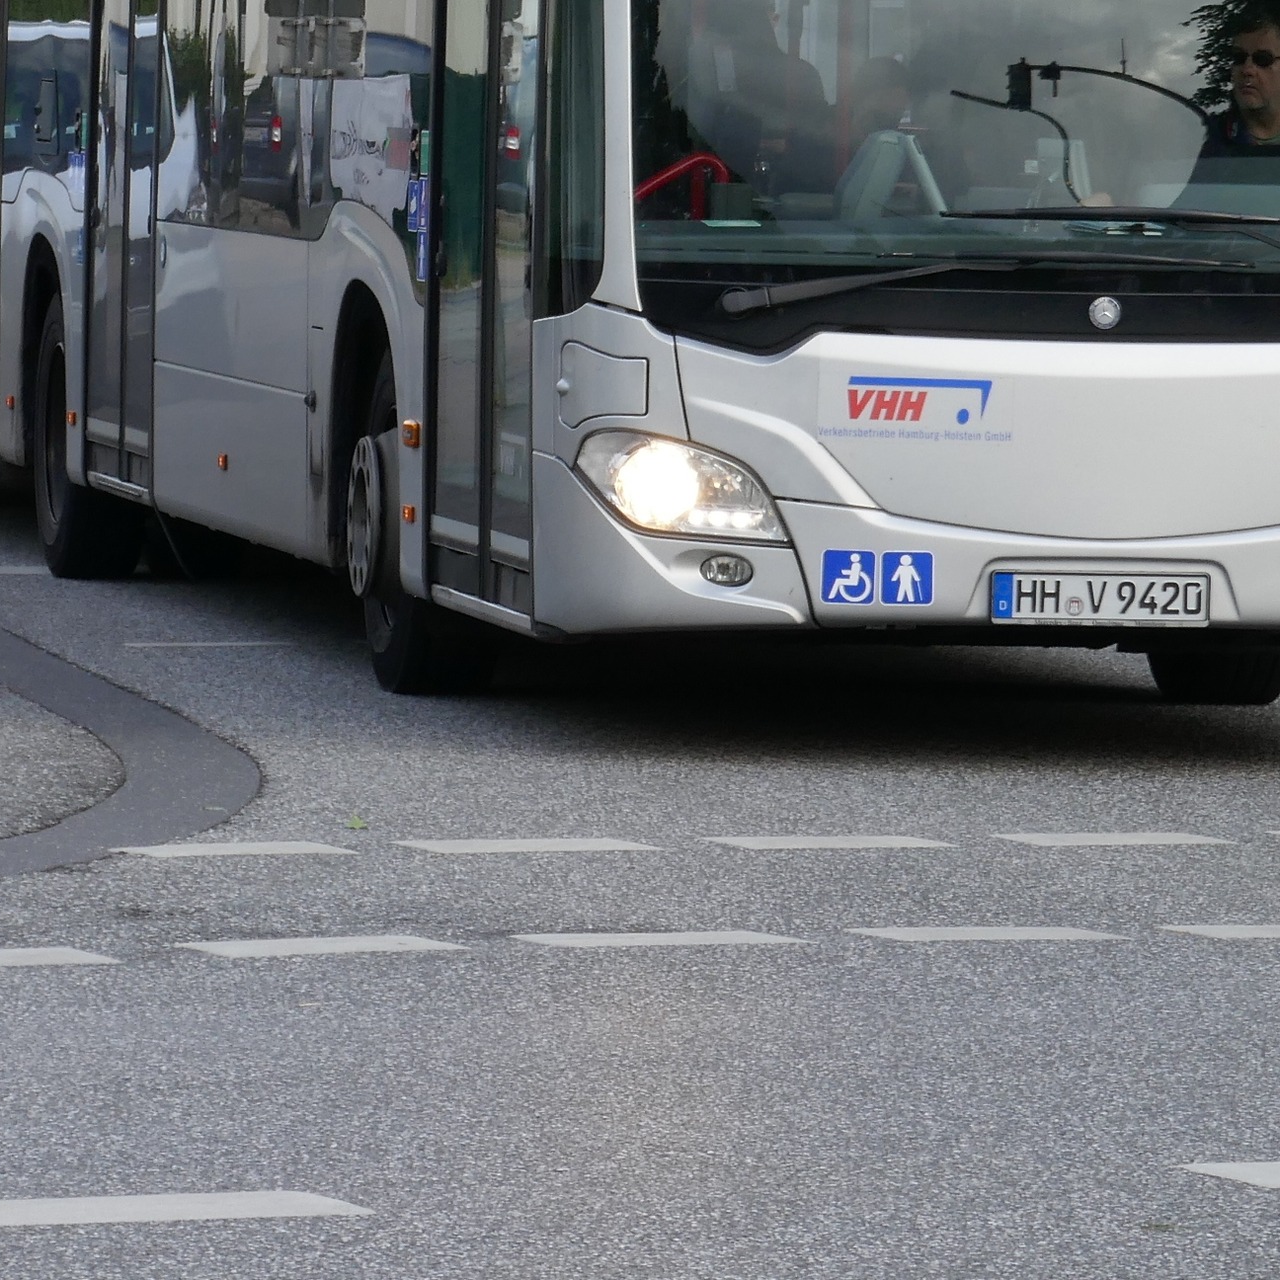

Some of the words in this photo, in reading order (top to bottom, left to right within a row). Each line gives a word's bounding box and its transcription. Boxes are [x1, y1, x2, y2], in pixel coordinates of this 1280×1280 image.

[847, 389, 928, 421] VHH
[818, 427, 896, 439] Verkehrsbetriebe
[898, 428, 982, 442] Hamburg-Holstein
[984, 431, 1012, 442] GmbH
[1016, 580, 1061, 613] HH
[1087, 581, 1108, 614] V
[1117, 581, 1203, 615] 9420
